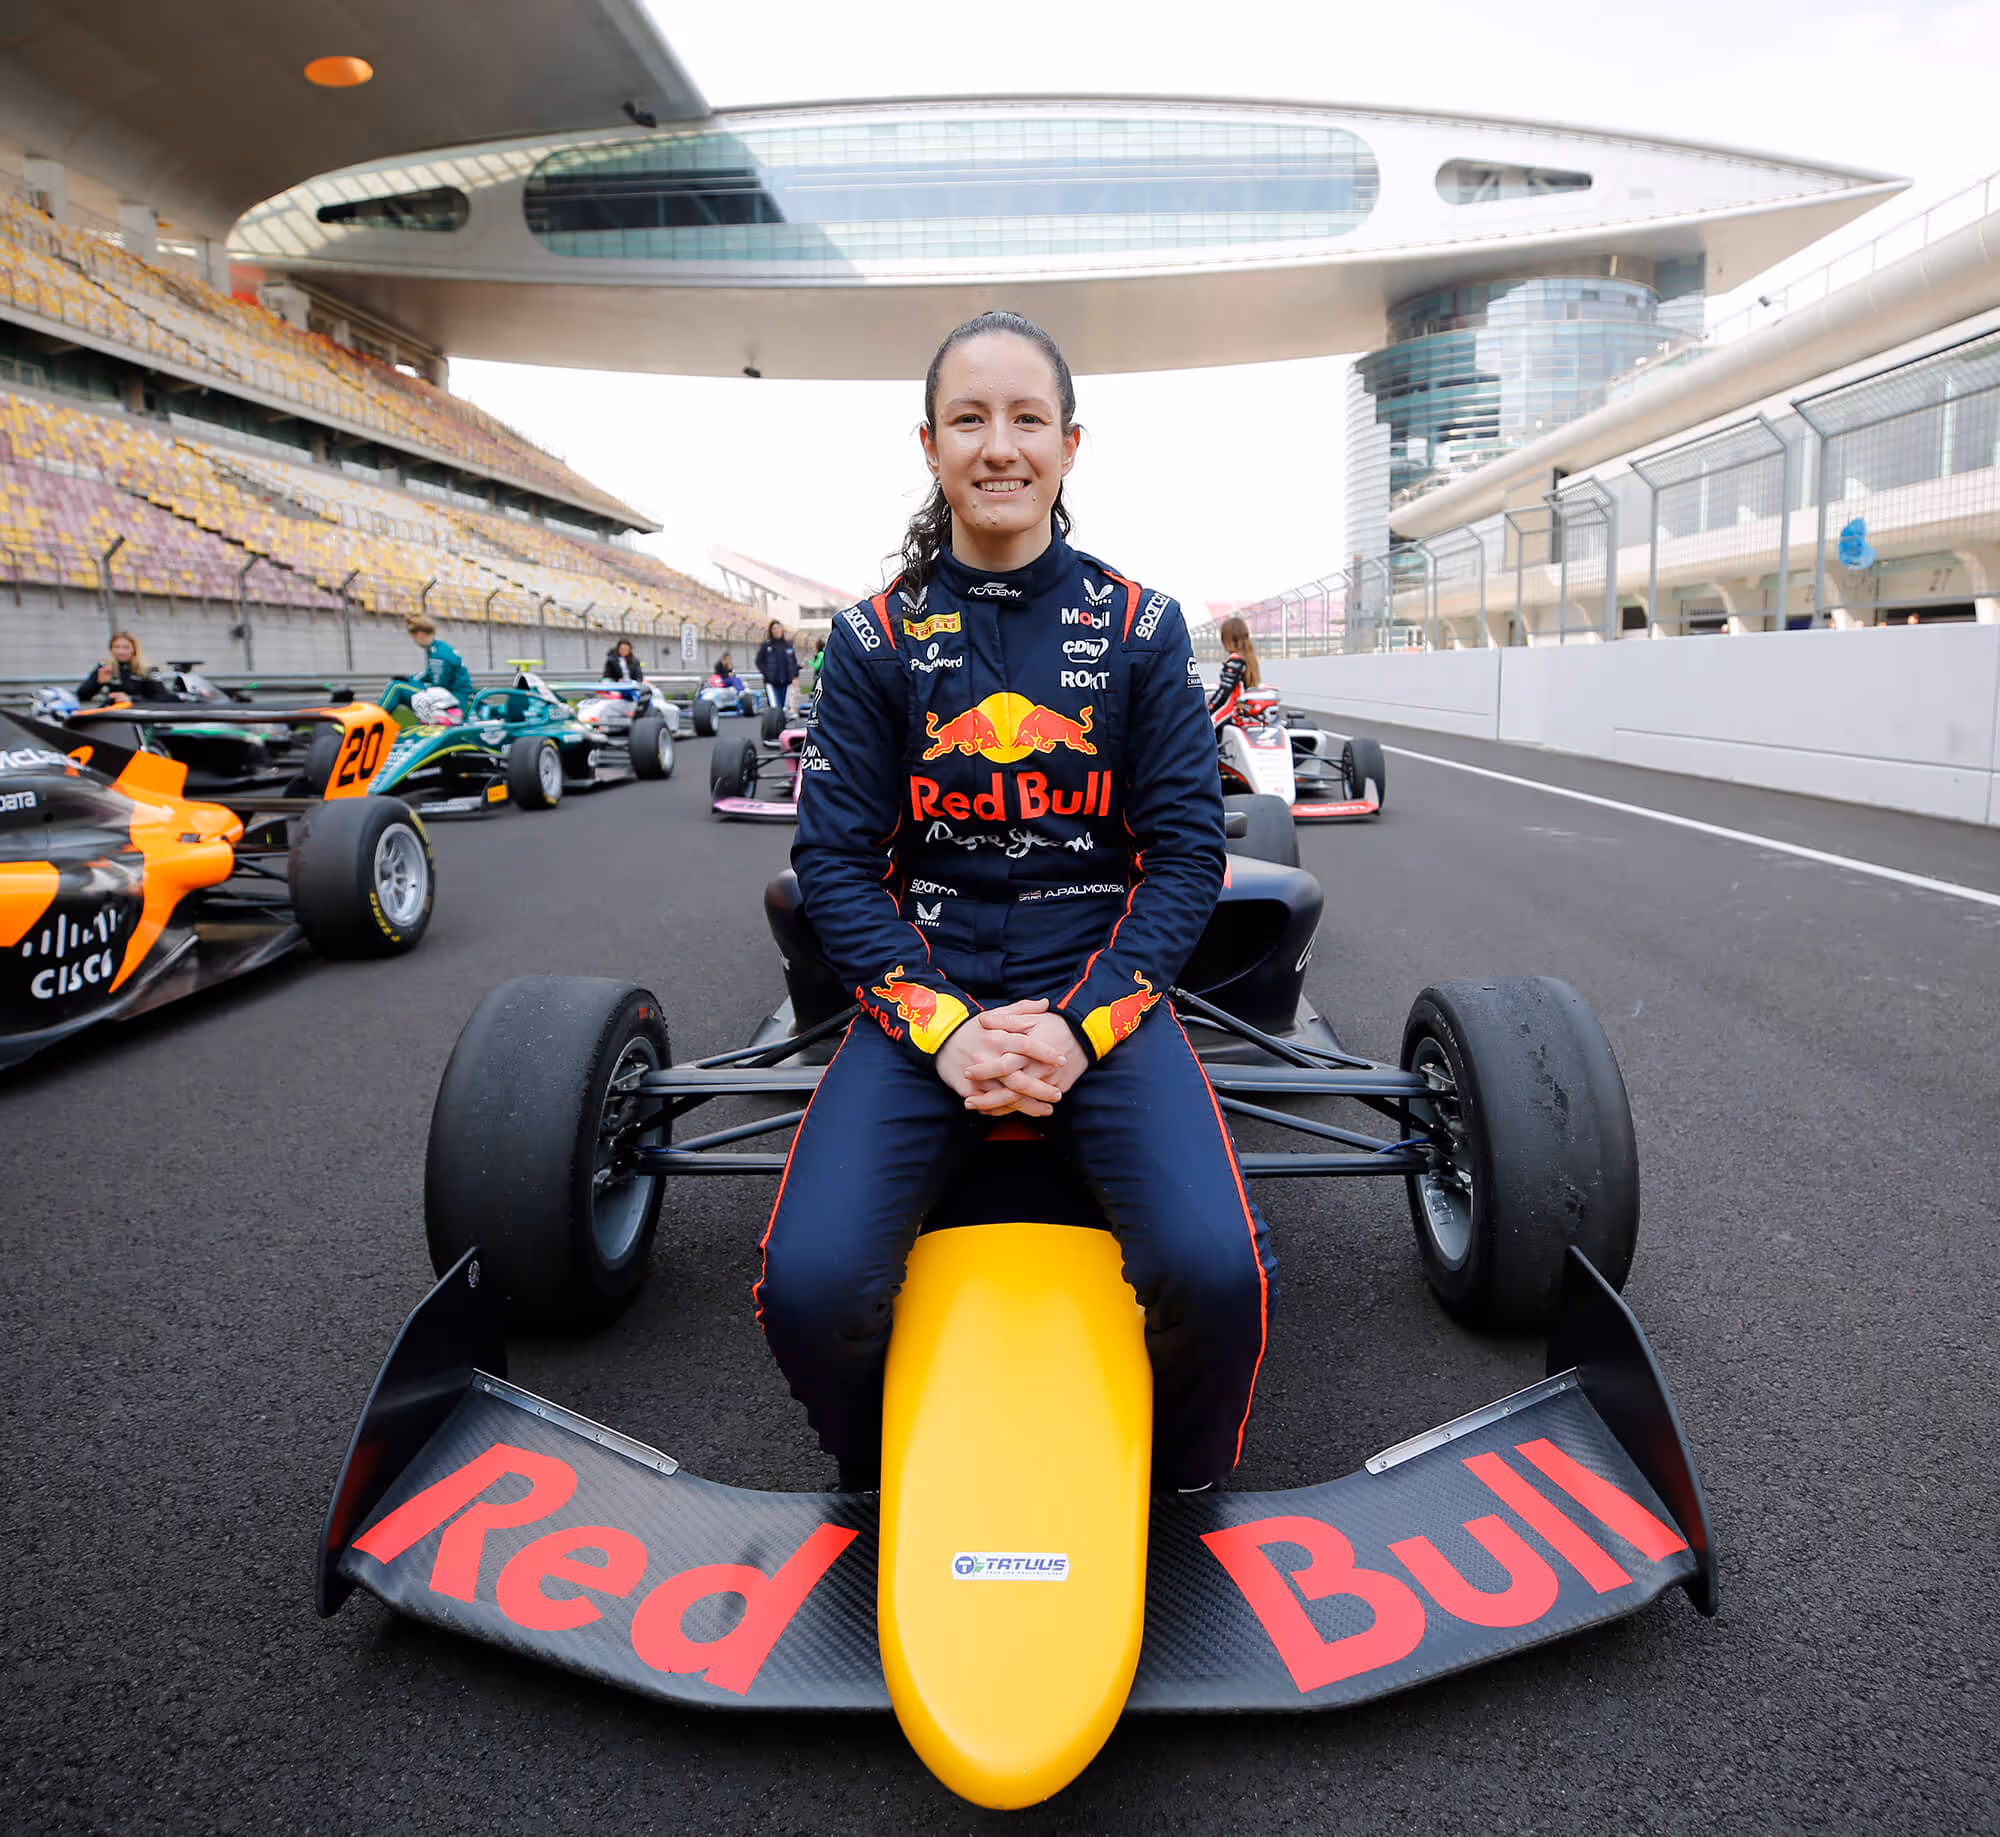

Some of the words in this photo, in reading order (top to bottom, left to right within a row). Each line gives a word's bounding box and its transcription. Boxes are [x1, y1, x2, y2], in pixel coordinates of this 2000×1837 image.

[967, 586, 1022, 598] ACADEMY
[335, 721, 385, 788] 20
[910, 772, 1006, 821] Red
[1016, 770, 1112, 820] Bull
[351, 1442, 859, 1696] Red
[1199, 1437, 1690, 1694] Bull
